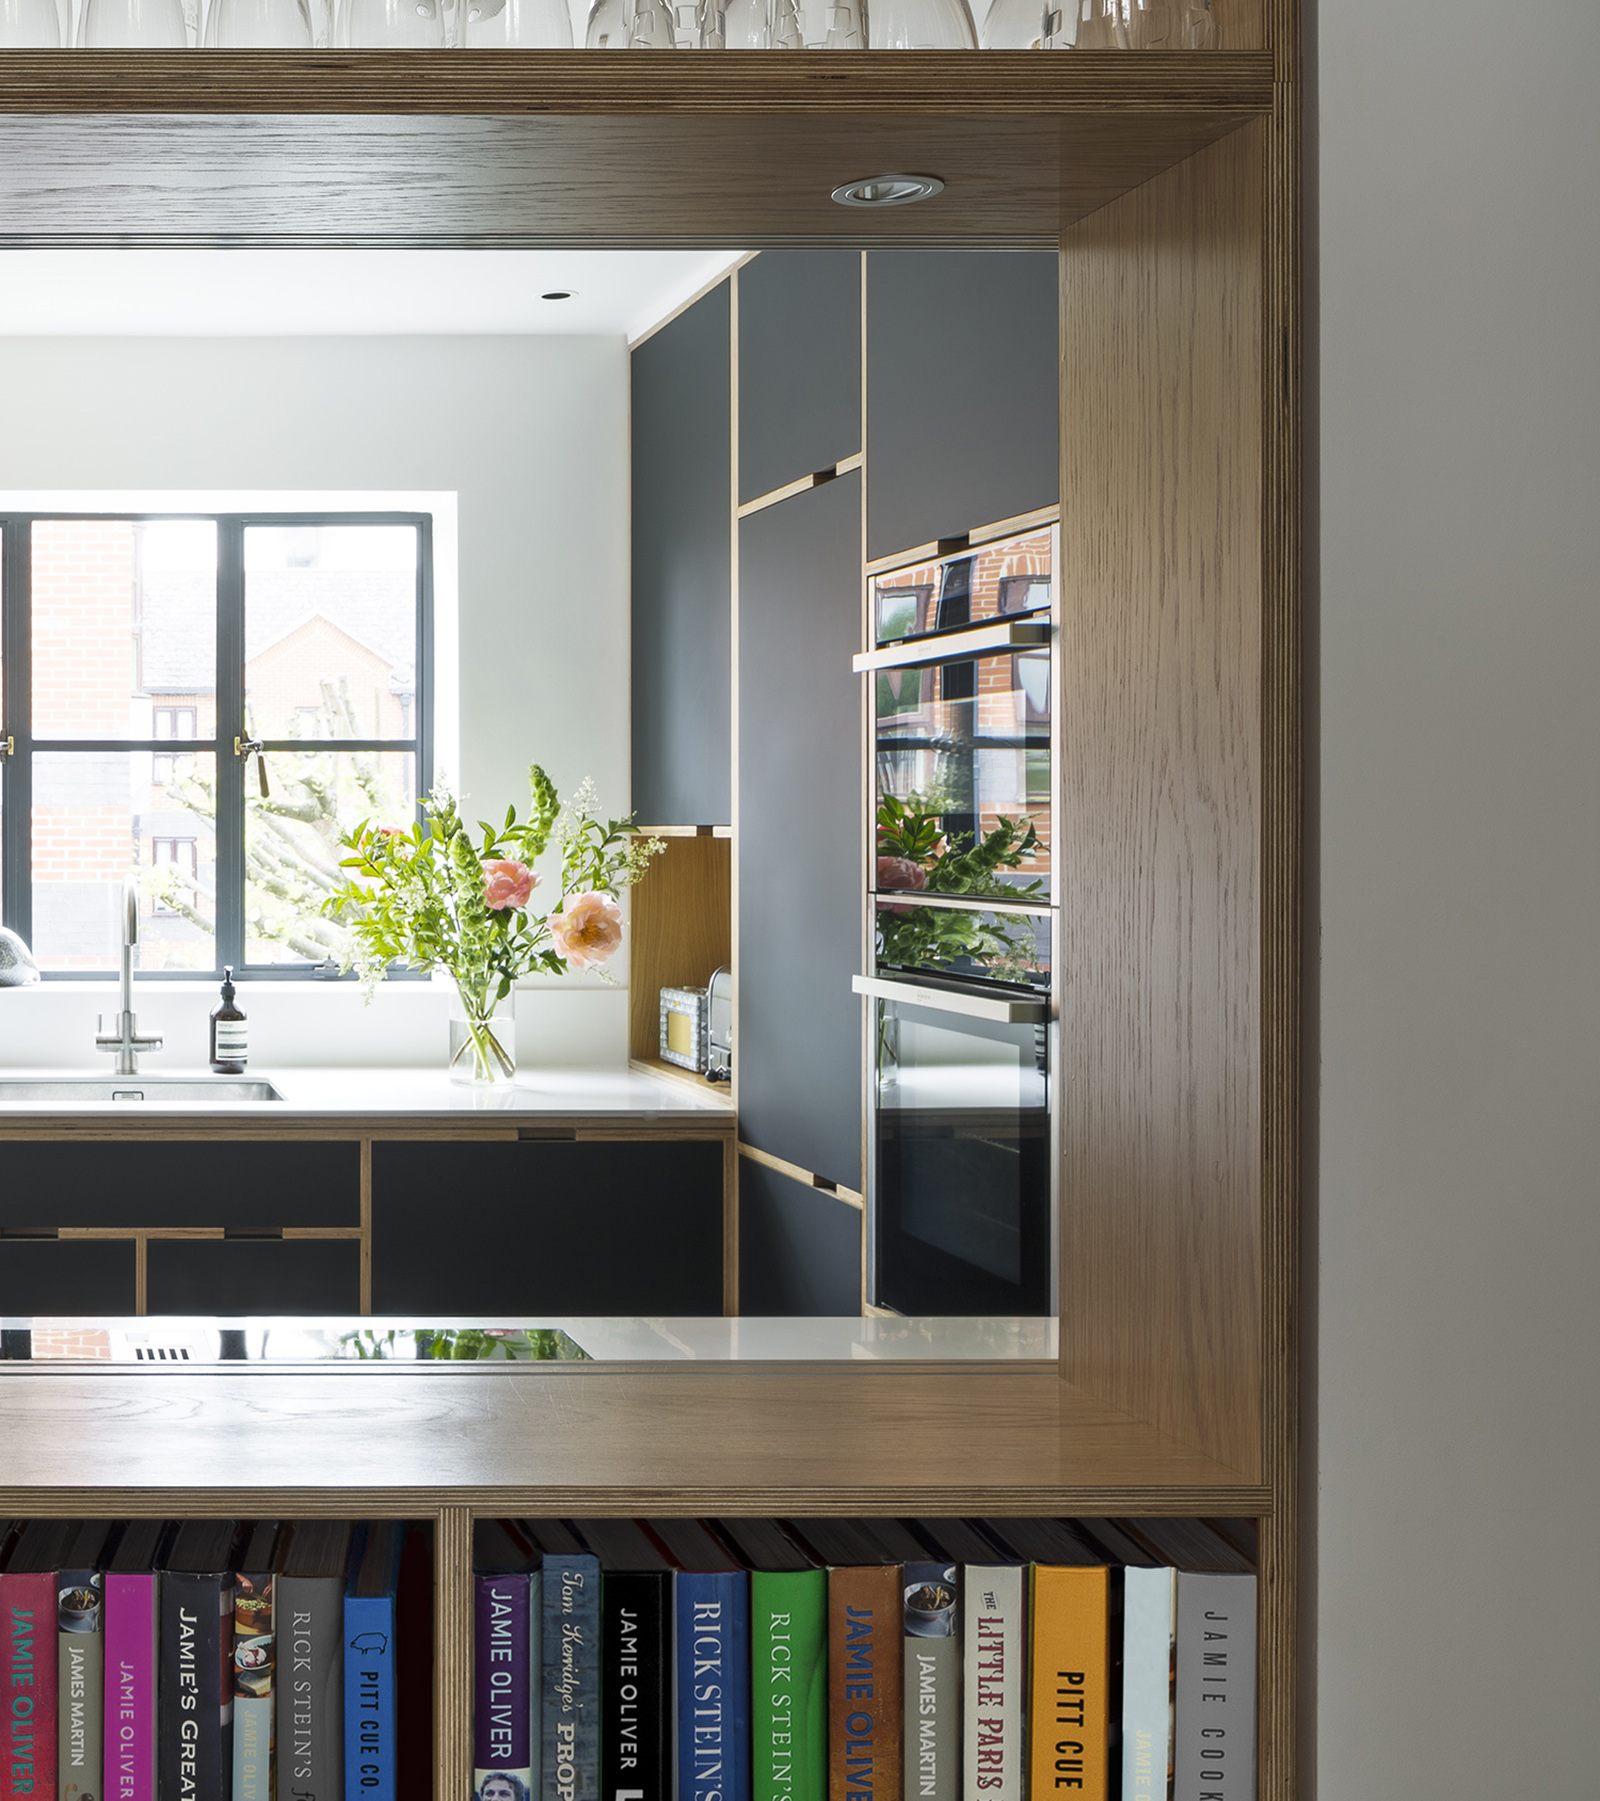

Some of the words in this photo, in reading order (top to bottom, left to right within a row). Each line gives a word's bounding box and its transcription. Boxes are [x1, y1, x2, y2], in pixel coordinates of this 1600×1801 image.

[491, 1588, 512, 1662] JAMIE
[561, 1572, 584, 1614] Tom
[983, 1591, 998, 1610] THE
[12, 1607, 33, 1686] JAMIE
[69, 1647, 84, 1699] JAMES
[180, 1607, 199, 1711] JAMIE'S
[293, 1611, 311, 1672] RICK
[555, 1623, 584, 1713] Kerridge's
[620, 1609, 637, 1677] JAMIE
[693, 1601, 722, 1676] RICK
[771, 1612, 791, 1683] RICK
[846, 1606, 873, 1700] JAMIE
[978, 1616, 1005, 1707] LITTLE
[1202, 1611, 1229, 1703] JAMIE
[120, 1661, 134, 1720] JAMIE
[360, 1672, 379, 1711] PITT
[490, 1672, 512, 1759] OLIVER
[917, 1654, 936, 1716] JAMES
[1056, 1671, 1085, 1728] PITT
[12, 1696, 34, 1794] OLIVER
[70, 1703, 85, 1766] MARTIN
[120, 1726, 134, 1799] OLIVER
[244, 1710, 258, 1760] JAMIE
[293, 1682, 313, 1779] STEIN'S
[360, 1720, 379, 1755] CUE
[620, 1684, 638, 1770] OLIVER
[918, 1721, 937, 1796] MARTIN
[977, 1717, 1005, 1791] PARIS
[1135, 1730, 1151, 1787] JAMIE
[360, 1764, 380, 1795] CO.
[1055, 1741, 1084, 1790] CUE
[1200, 1728, 1226, 1801] COOK
